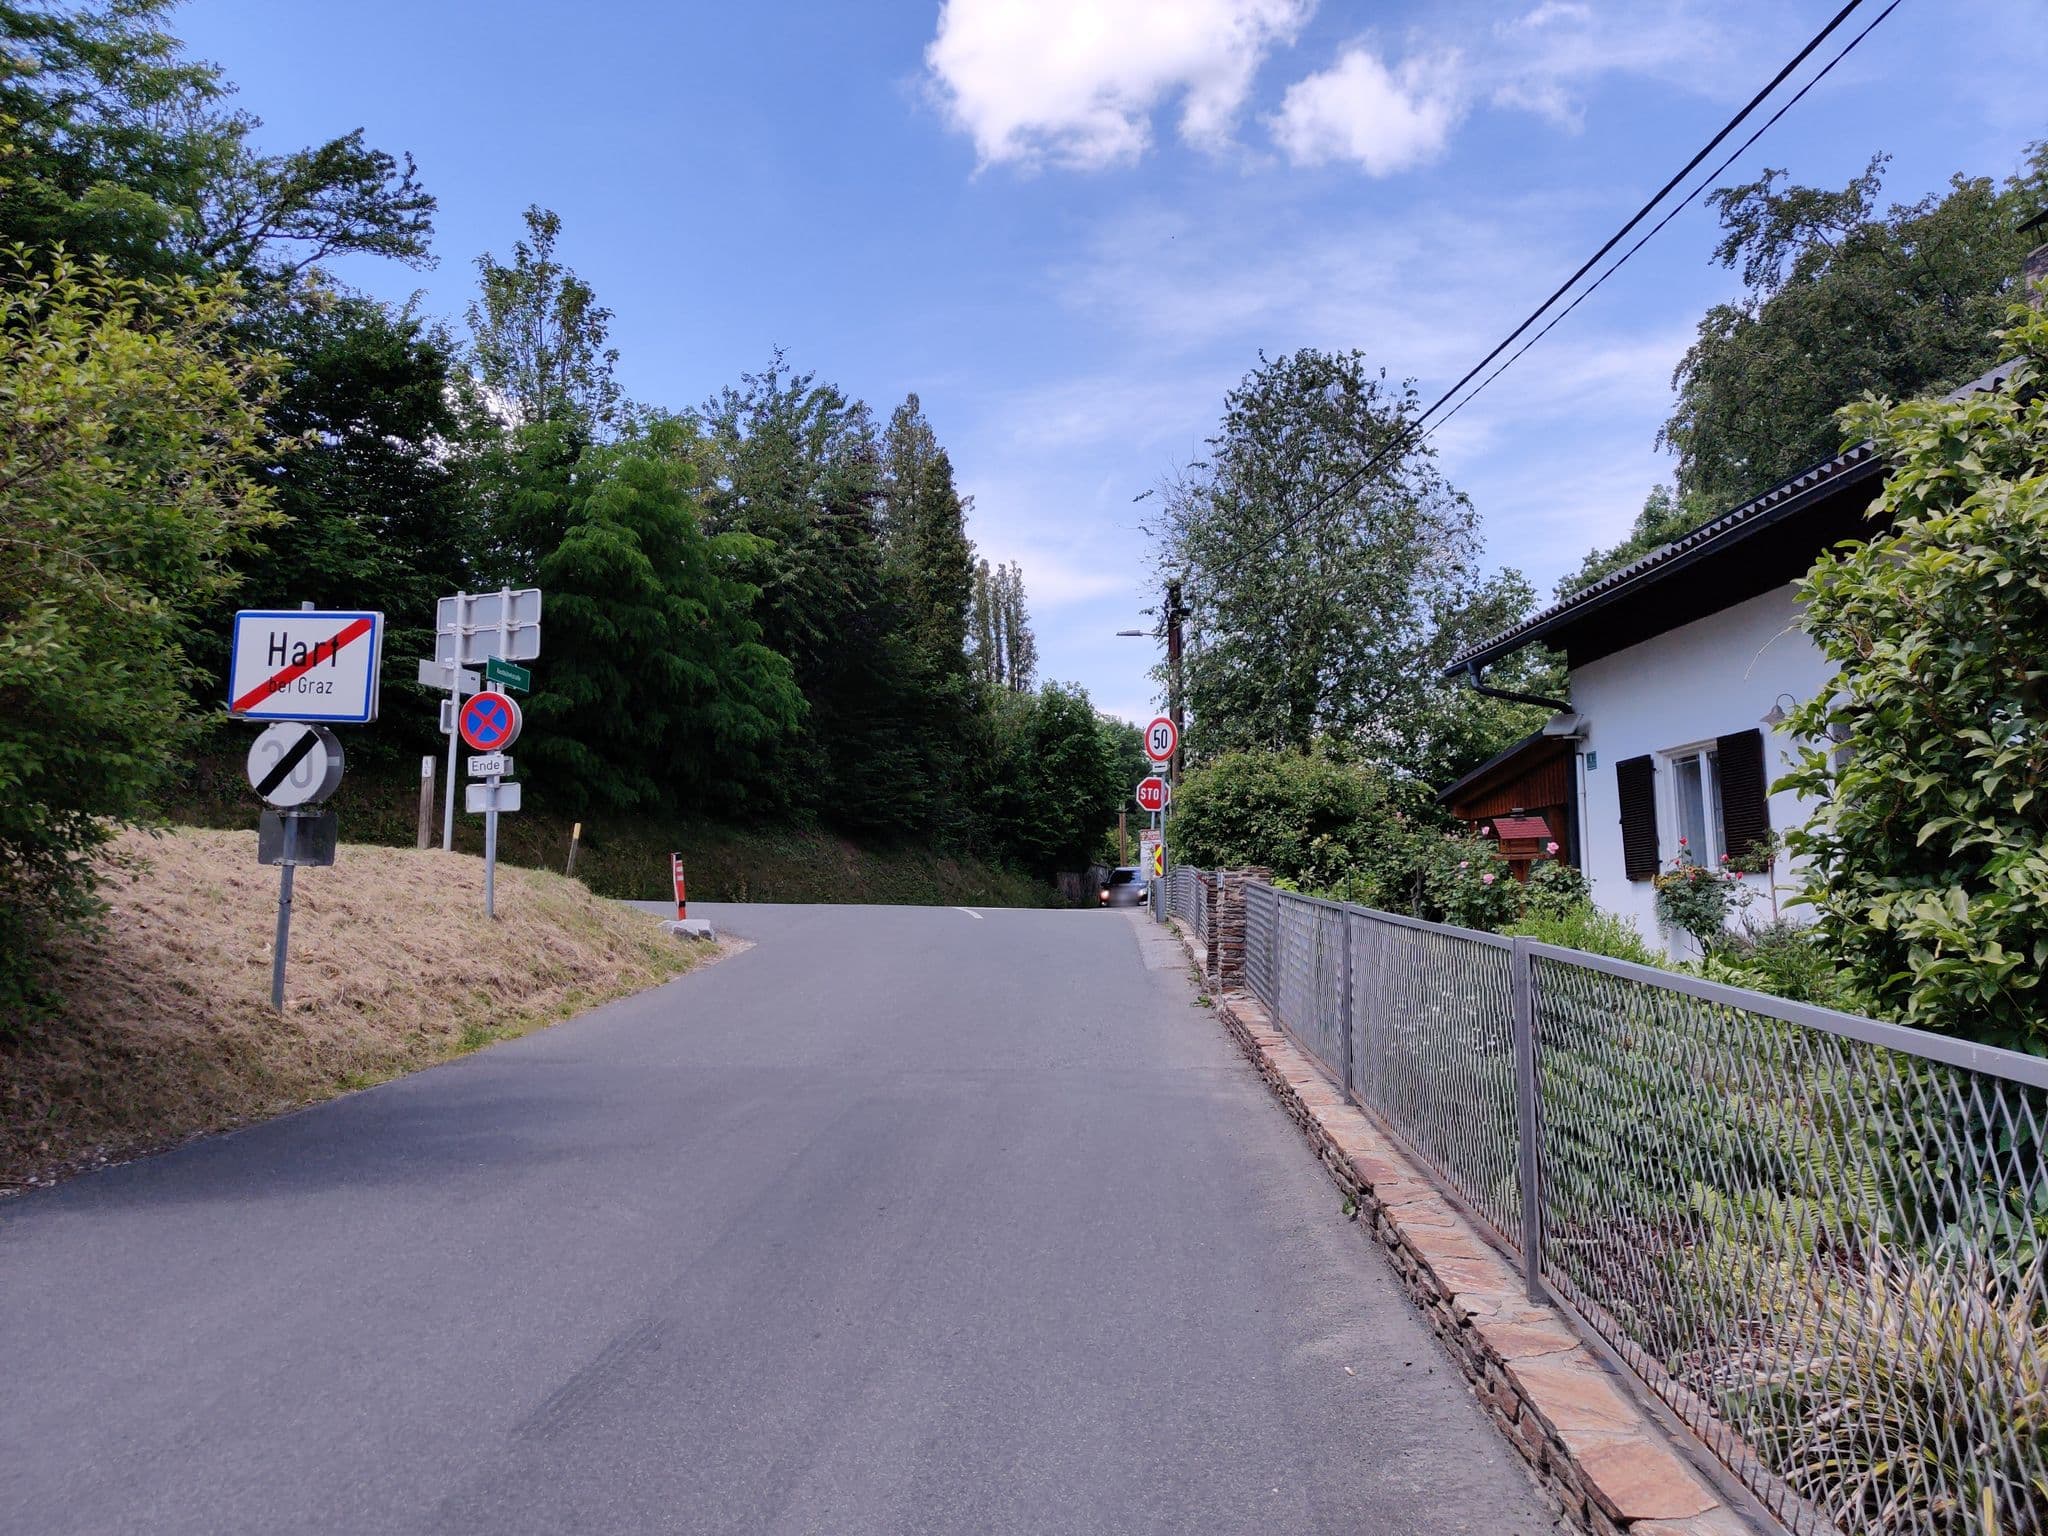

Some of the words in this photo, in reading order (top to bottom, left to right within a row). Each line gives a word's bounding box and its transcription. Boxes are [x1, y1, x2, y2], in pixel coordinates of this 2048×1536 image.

[268, 631, 339, 668] Hart
[268, 678, 291, 695] bei
[297, 677, 333, 695] Graz
[1153, 728, 1168, 750] 50
[471, 760, 500, 773] Ende
[1140, 787, 1163, 801] STO
